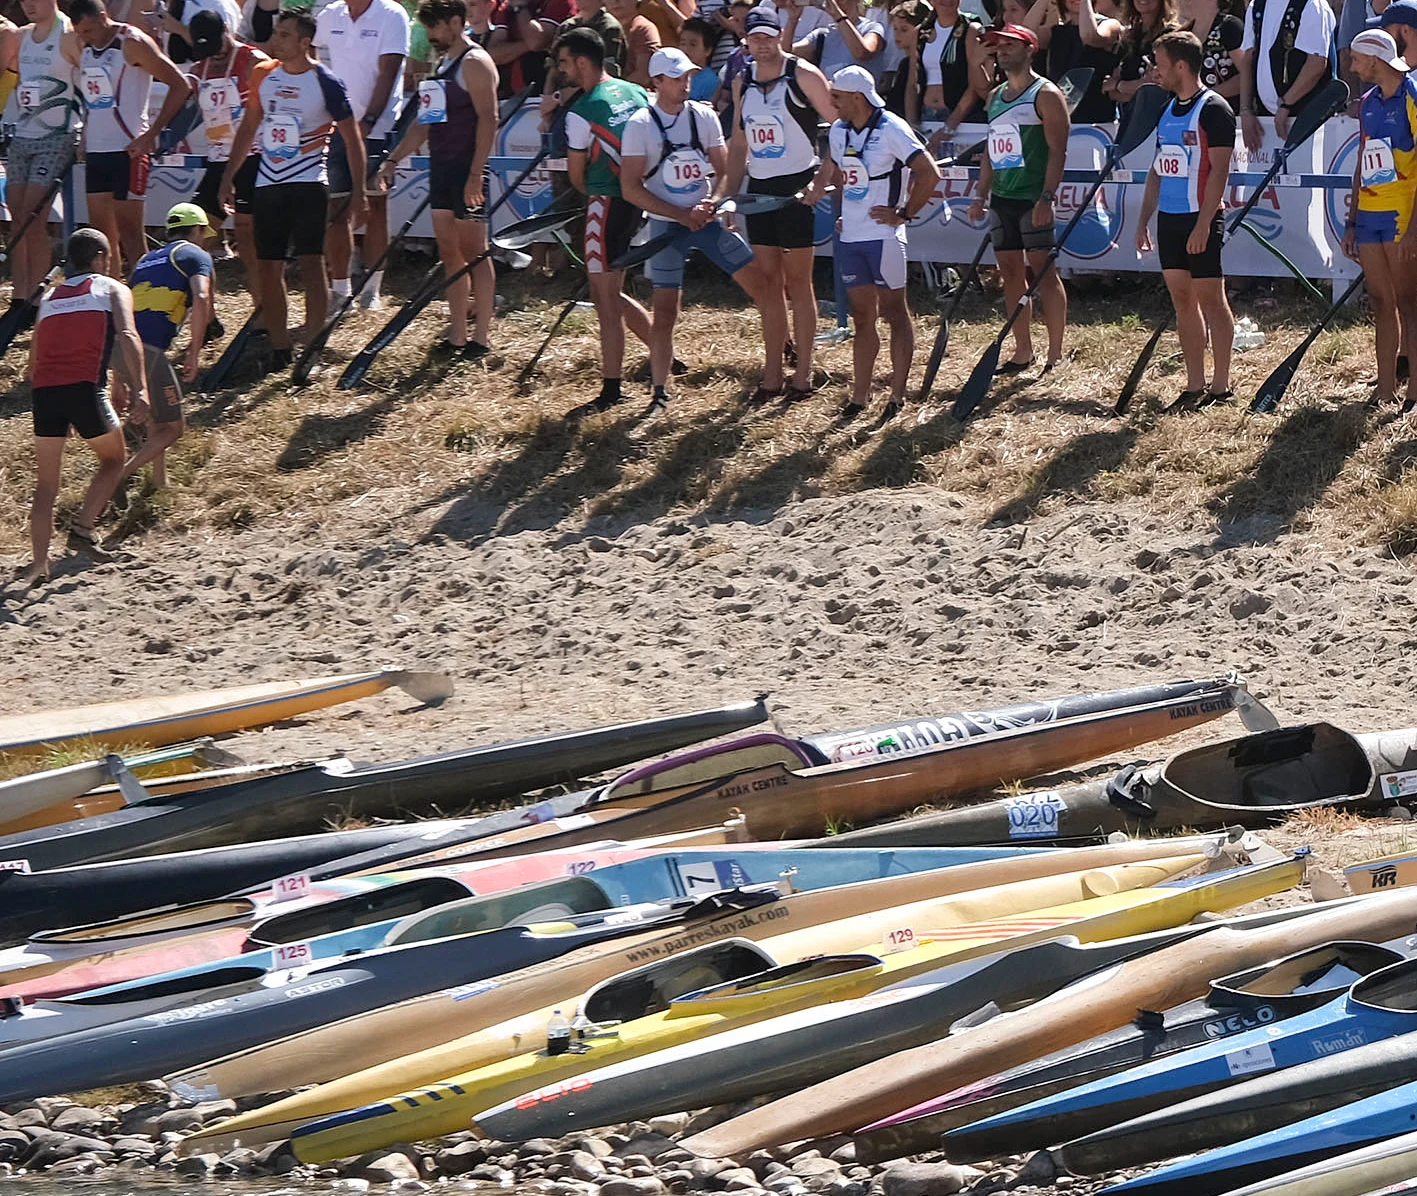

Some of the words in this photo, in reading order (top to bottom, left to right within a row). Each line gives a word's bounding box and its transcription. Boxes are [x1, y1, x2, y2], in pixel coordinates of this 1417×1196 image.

[87, 81, 101, 96] 96
[210, 90, 226, 106] 97
[271, 128, 287, 144] 98
[751, 128, 776, 146] 104
[992, 139, 1013, 155] 106
[1159, 158, 1180, 175] 108
[1363, 152, 1384, 170] 111
[674, 164, 702, 181] 103
[717, 784, 752, 802] KAYAK
[753, 774, 790, 794] CENTRE
[1009, 805, 1058, 829] 020
[278, 877, 307, 894] 121
[625, 903, 791, 964] www.parreskayak.com
[888, 929, 915, 945] 129
[277, 945, 308, 962] 125
[290, 978, 344, 999] ASTOR
[1204, 1007, 1275, 1040] NELO
